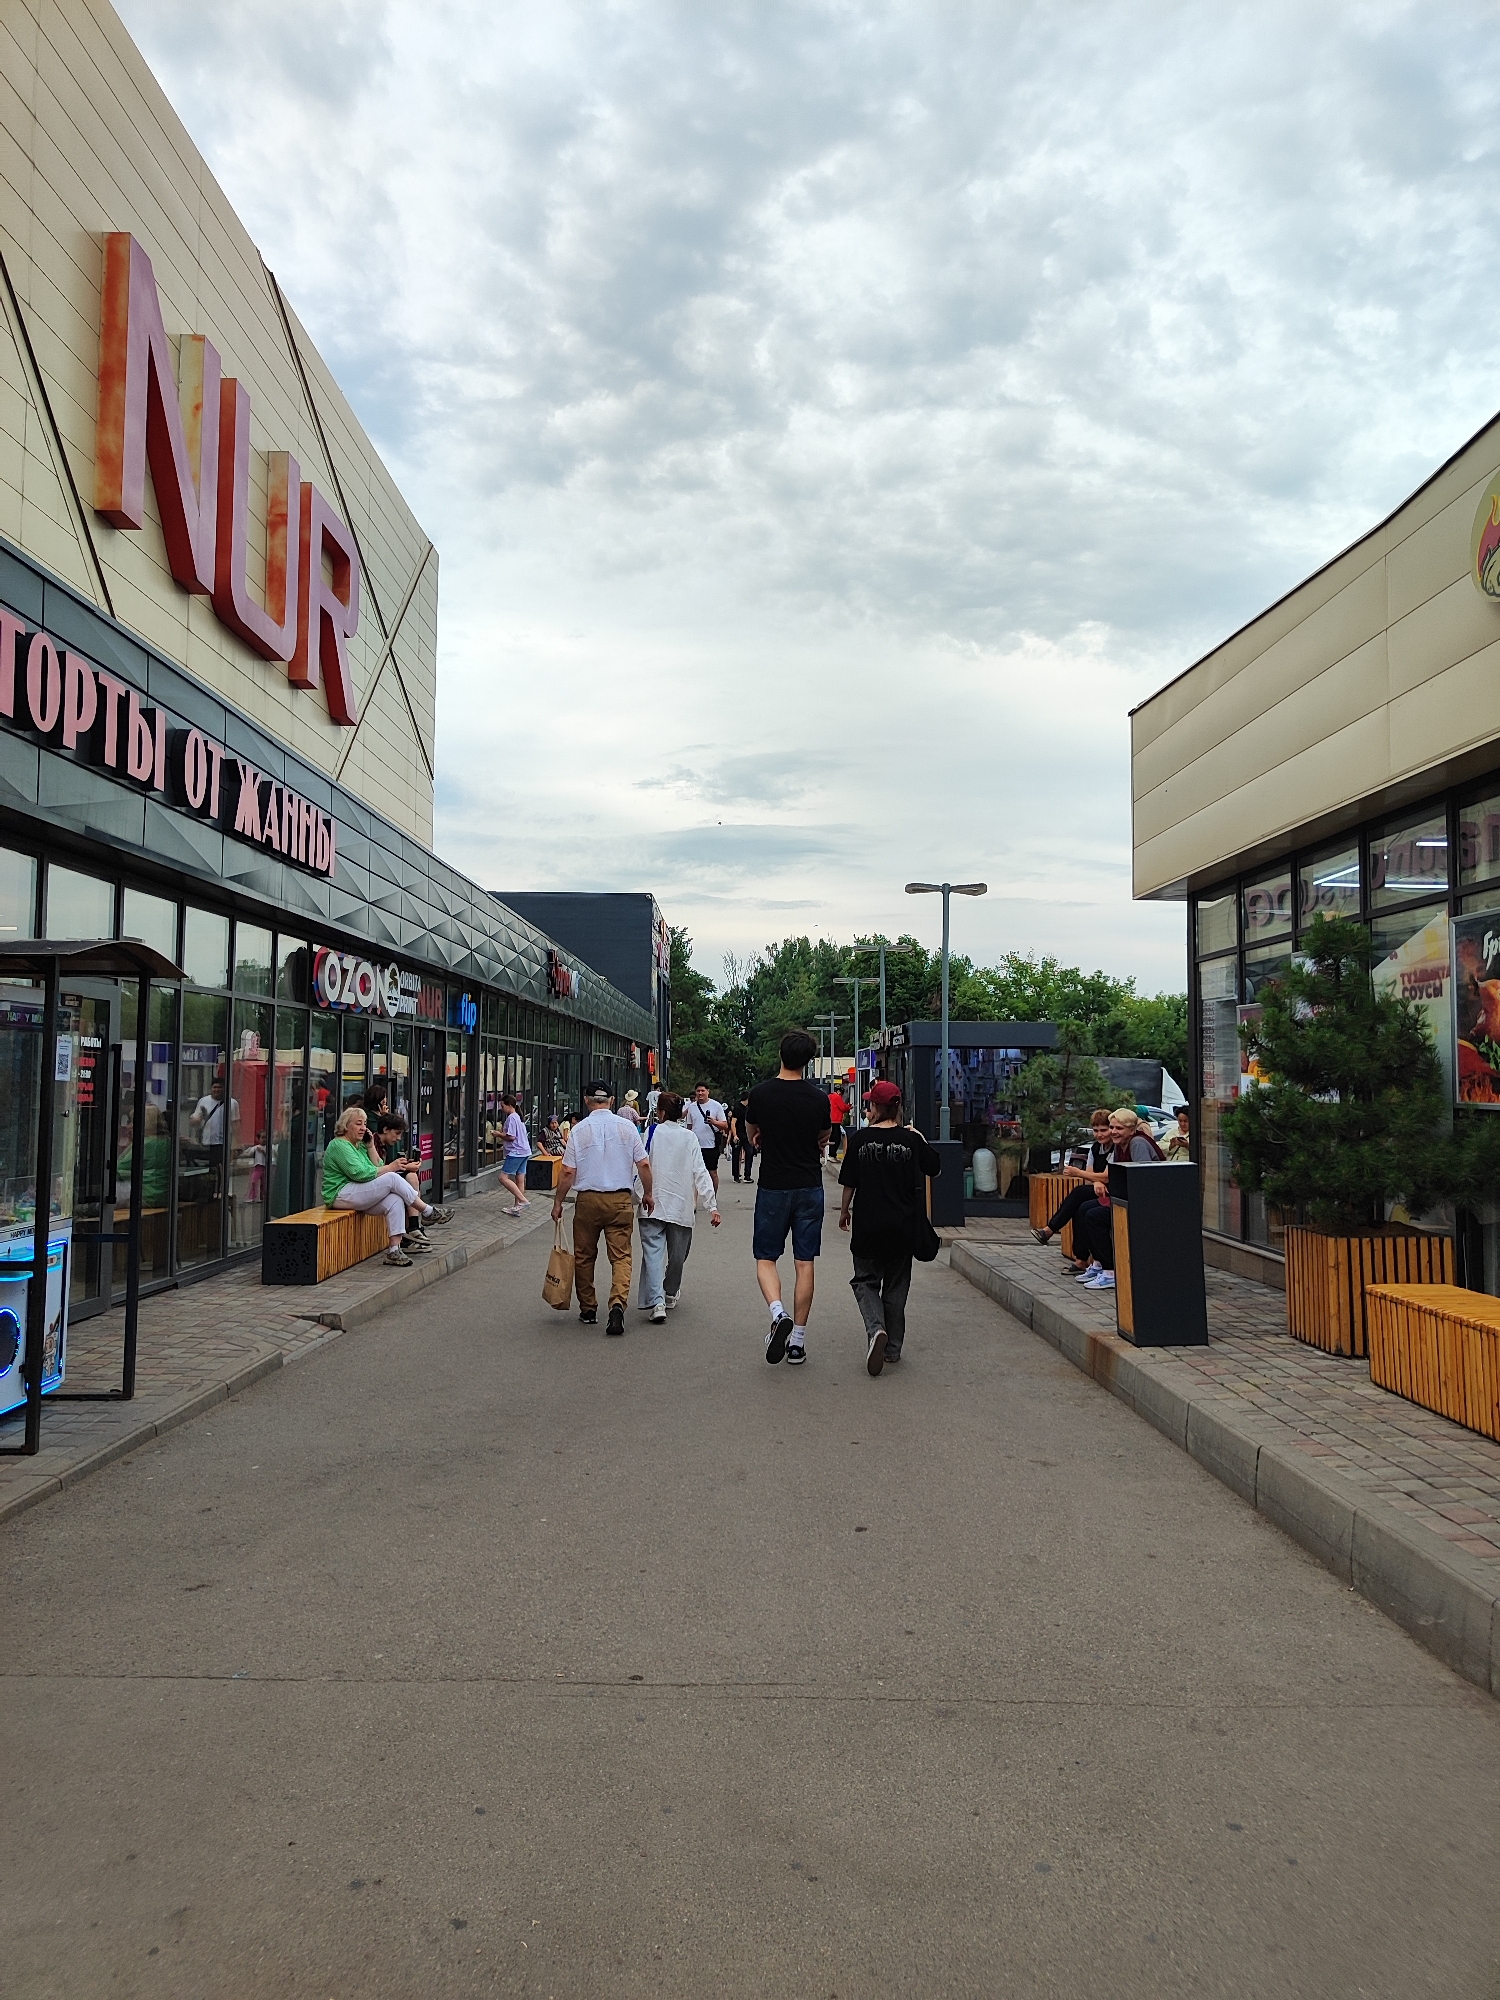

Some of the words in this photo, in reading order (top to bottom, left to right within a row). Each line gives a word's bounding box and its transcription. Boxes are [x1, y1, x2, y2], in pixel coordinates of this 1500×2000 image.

[95, 231, 360, 726] NUR
[0, 608, 166, 793] ТОРТЫ
[180, 728, 226, 820] ОТ
[233, 757, 336, 879] ЖАННЫ
[1483, 930, 1500, 971] Гр
[323, 950, 391, 1014] OZON
[400, 970, 422, 993] ORBITA
[417, 983, 443, 1020] NUR
[1401, 979, 1443, 1001] СОУСЫ
[399, 994, 419, 1015] PRINT
[461, 992, 477, 1034] flip
